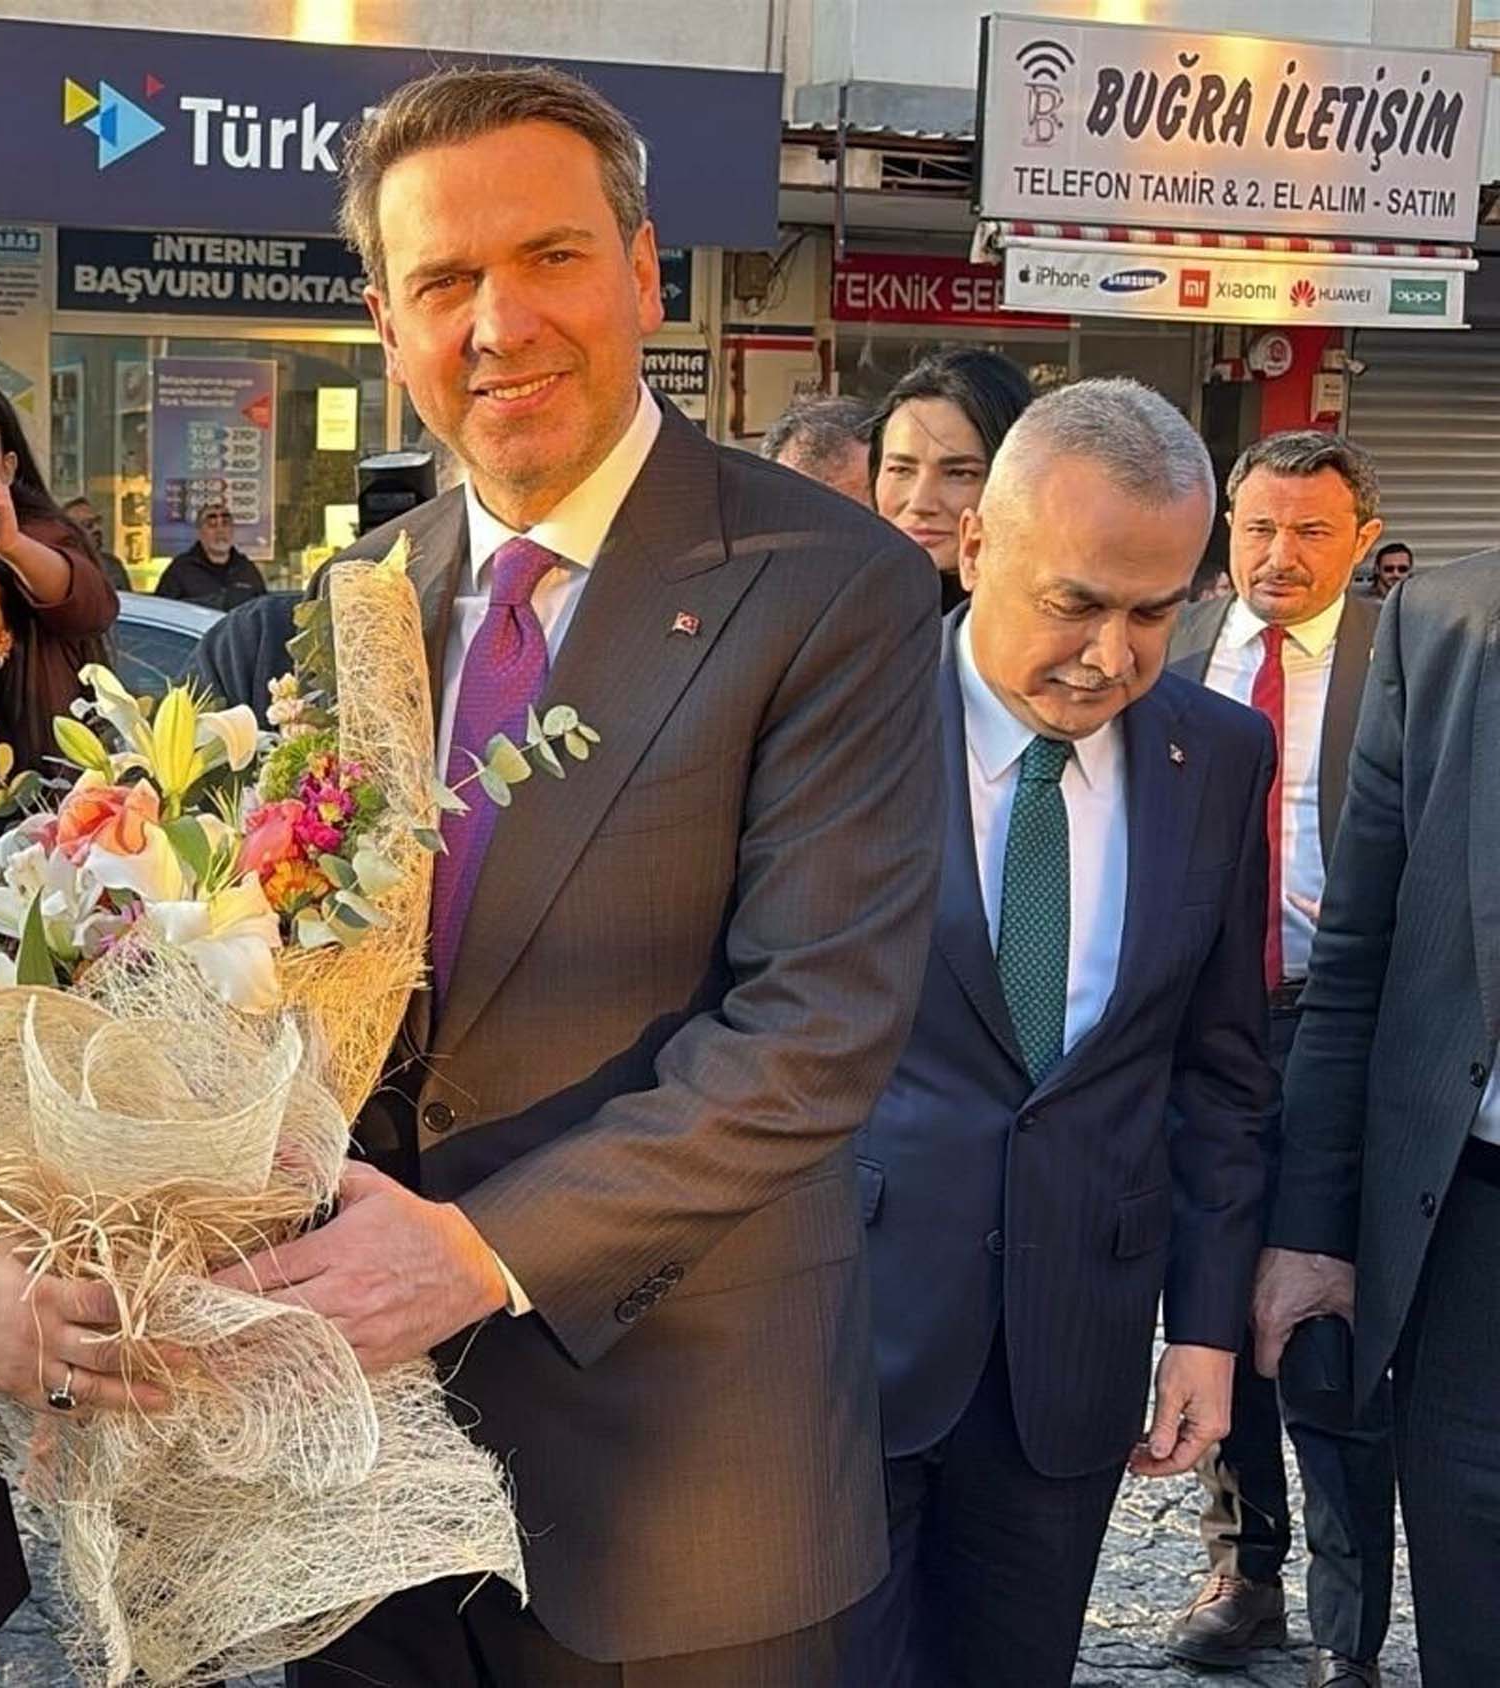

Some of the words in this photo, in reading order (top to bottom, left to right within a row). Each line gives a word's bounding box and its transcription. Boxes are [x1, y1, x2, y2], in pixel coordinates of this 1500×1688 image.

[1086, 52, 1252, 147] BUĞRA
[1265, 61, 1464, 171] İLETİŞİM
[180, 96, 341, 172] Türk
[1013, 166, 1131, 200] TELEFON
[1140, 171, 1215, 205] TAMİR
[1222, 179, 1238, 206] &
[1246, 181, 1265, 208] 2.
[1274, 182, 1302, 210] EL
[1308, 185, 1366, 213] ALIM
[1387, 188, 1456, 217] SATIM
[74, 265, 234, 303] BAŞVURU
[242, 273, 367, 303] NOKTAS
[1036, 266, 1091, 289] iPhone
[1319, 288, 1371, 303] HUAWEI
[644, 353, 704, 372] AVİNA
[647, 373, 704, 391] ETİŞİM
